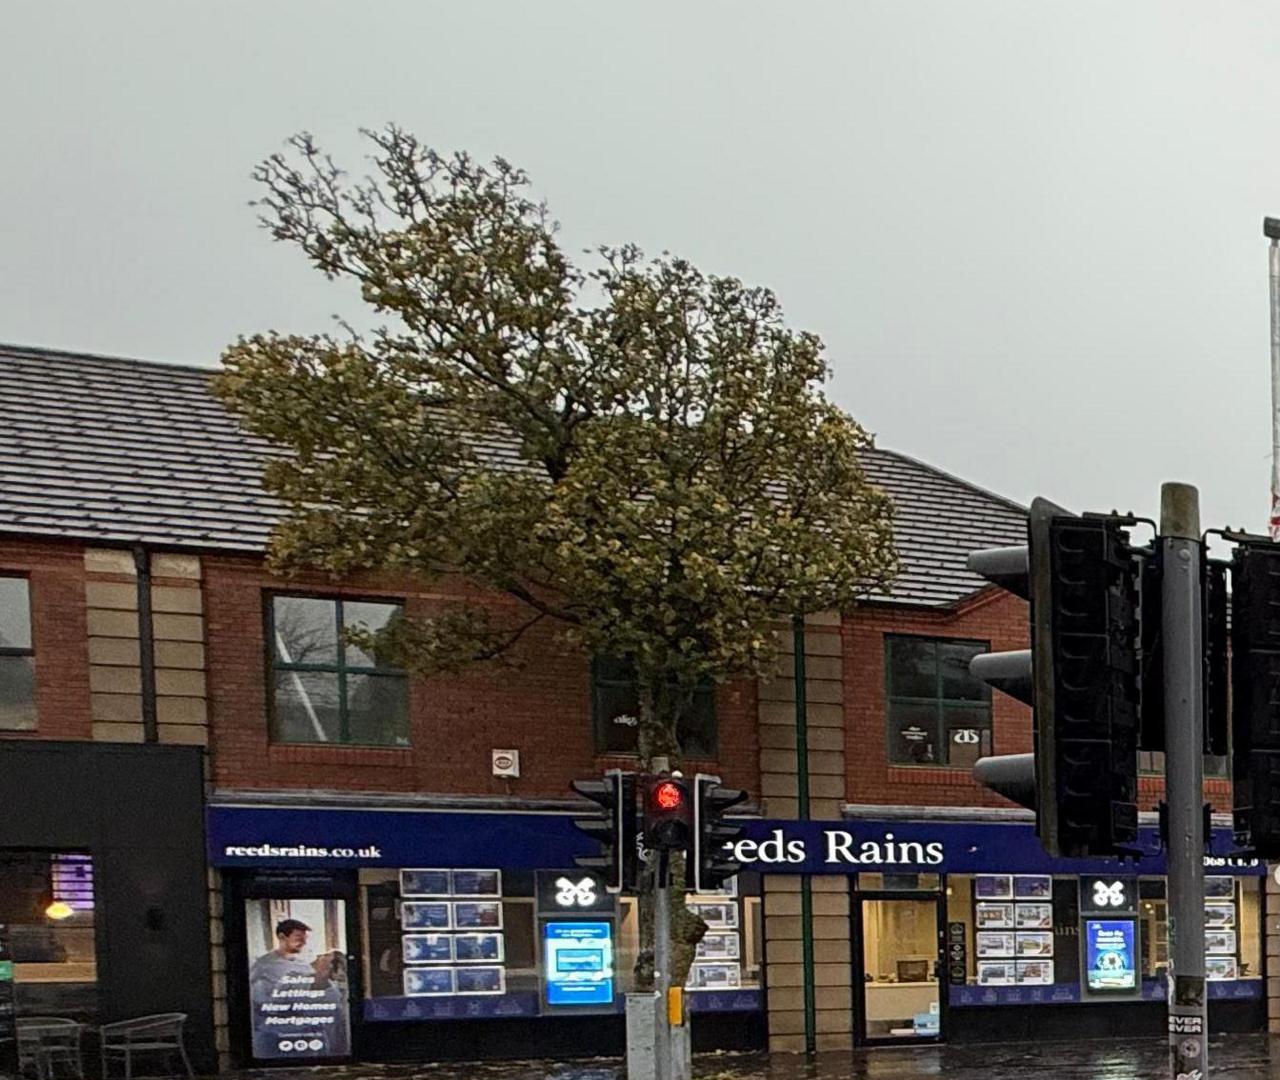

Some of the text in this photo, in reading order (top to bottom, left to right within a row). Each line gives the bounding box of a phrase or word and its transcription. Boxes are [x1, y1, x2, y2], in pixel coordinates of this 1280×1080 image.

[225, 844, 383, 859] reedsrains.co.uk
[722, 829, 945, 865] eds Rains
[281, 976, 315, 984] Sales
[271, 989, 326, 999] Lettings
[261, 1003, 337, 1012] New Homes
[265, 1016, 335, 1026] Mortgages
